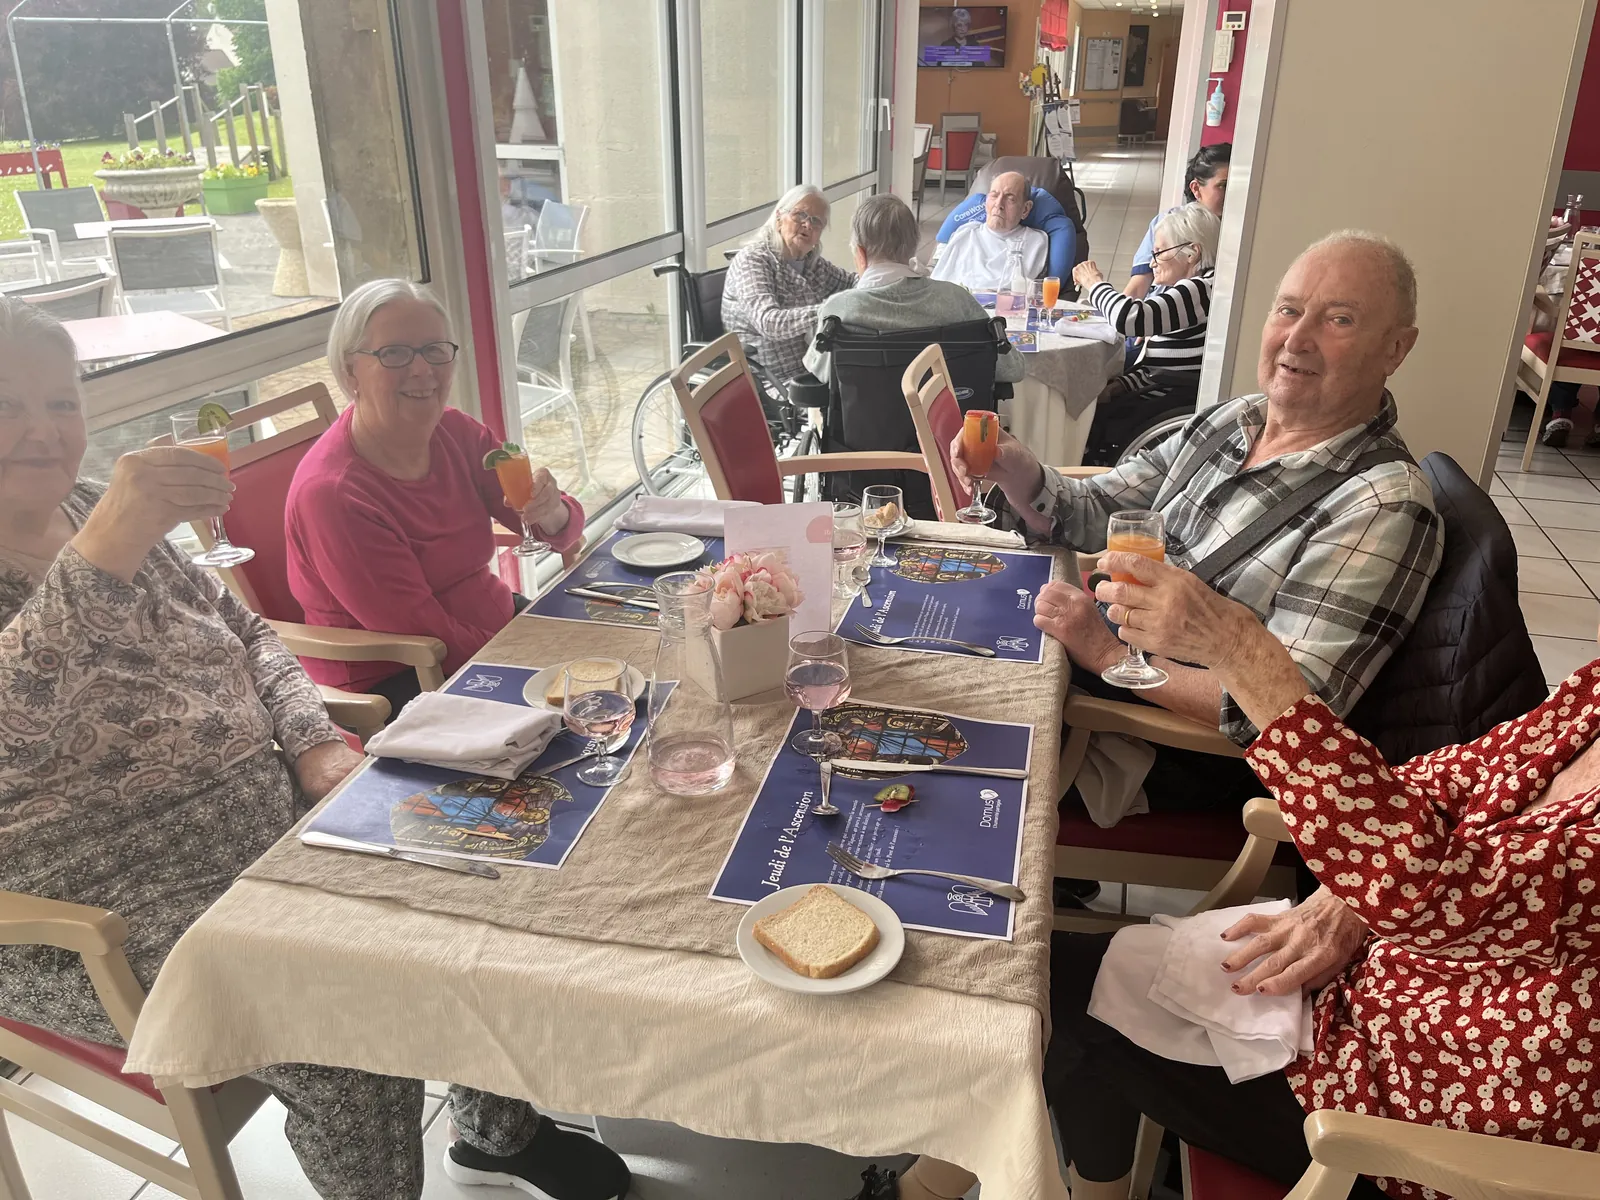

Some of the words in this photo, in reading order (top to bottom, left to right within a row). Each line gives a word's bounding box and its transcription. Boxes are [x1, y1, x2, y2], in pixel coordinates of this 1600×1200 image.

[779, 792, 813, 843] l'Ascension
[980, 799, 994, 827] Domus
[774, 845, 791, 858] de
[761, 859, 786, 890] Jeudi
